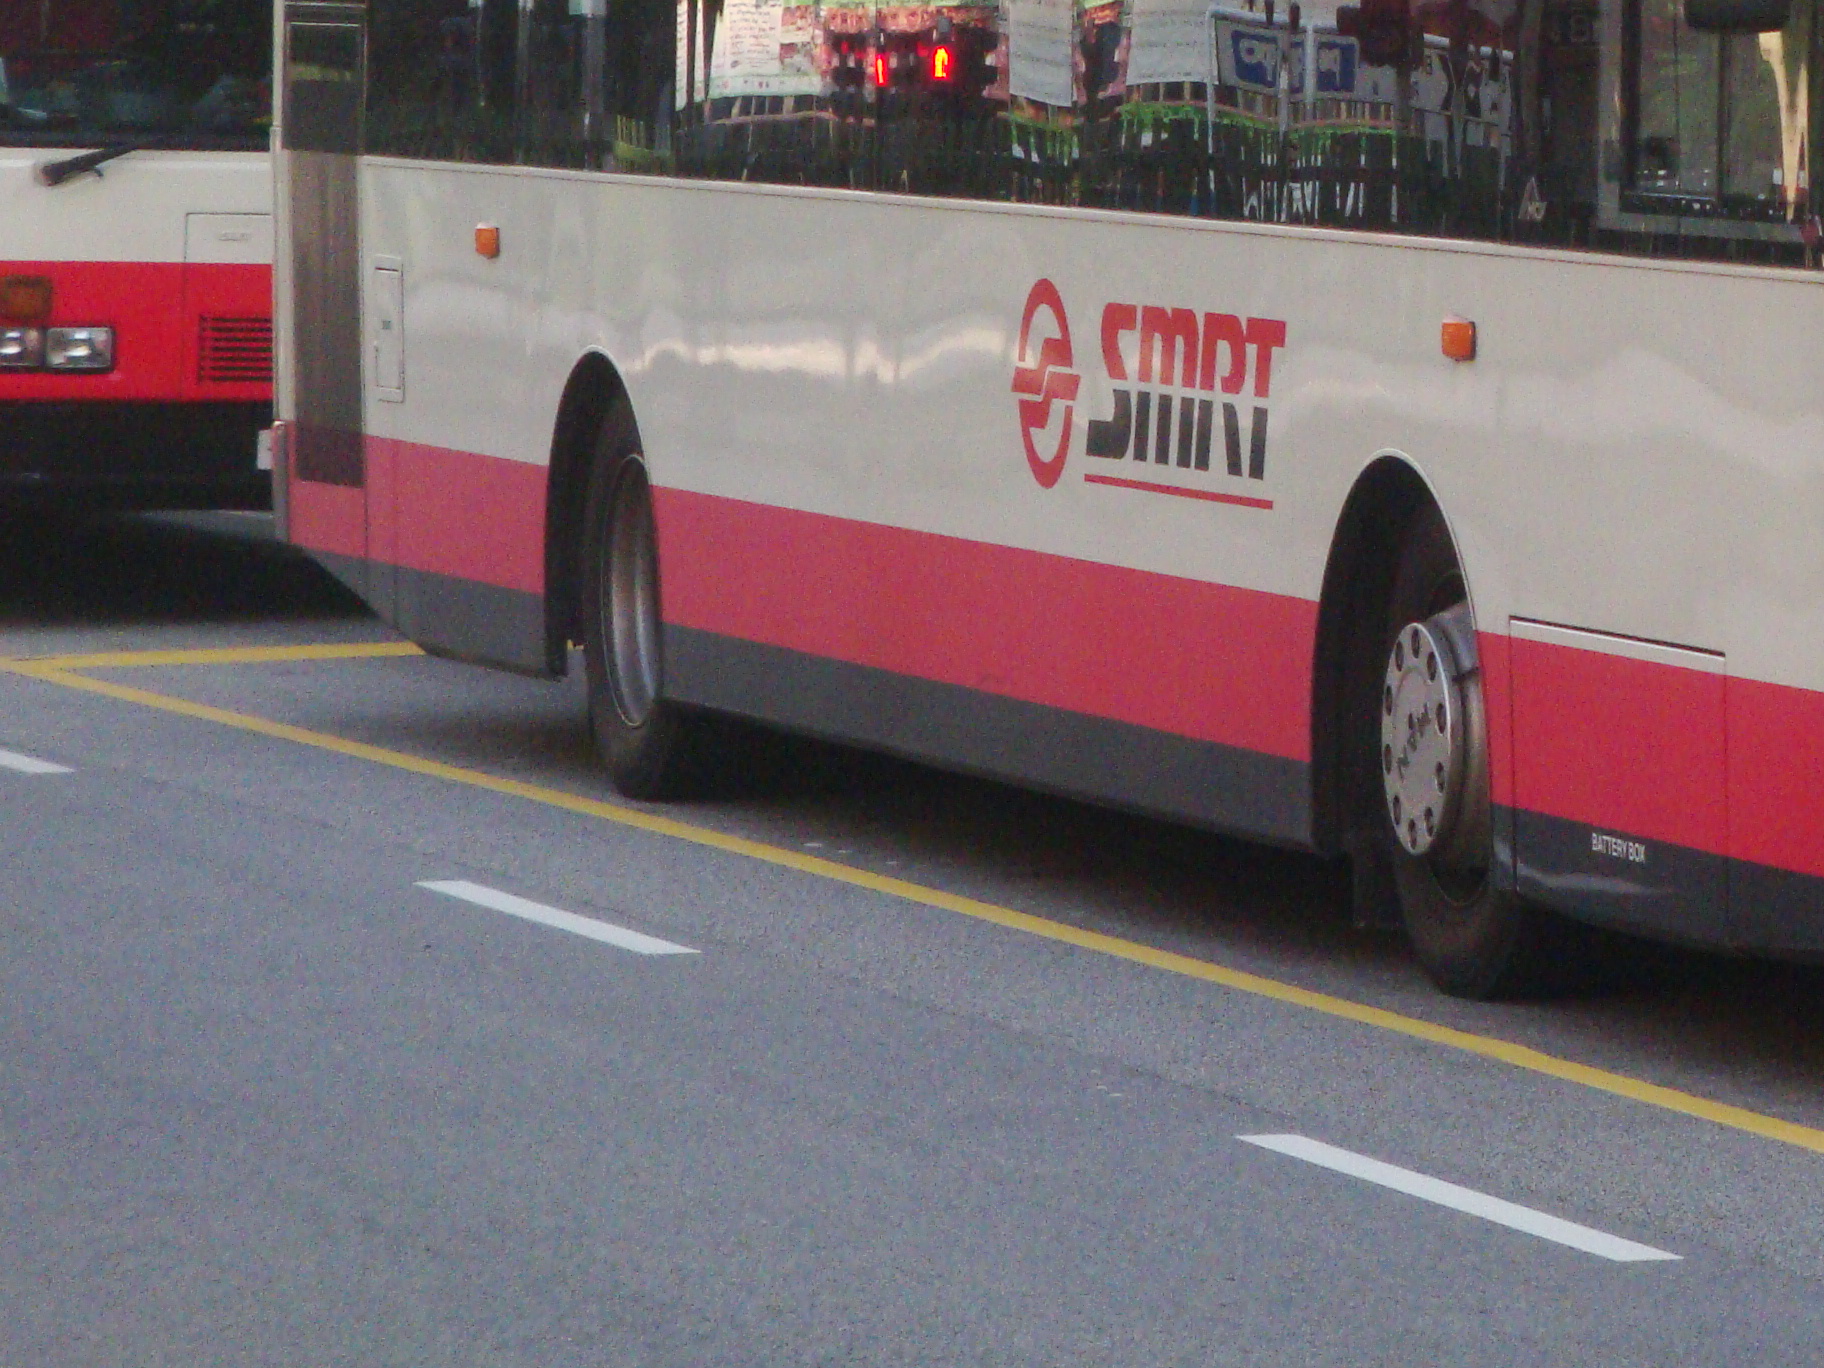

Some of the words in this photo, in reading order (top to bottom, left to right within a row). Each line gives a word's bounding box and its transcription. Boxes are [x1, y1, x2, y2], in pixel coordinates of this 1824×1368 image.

[1086, 301, 1287, 481] SMRT
[1591, 832, 1628, 859] BATTERY
[1628, 841, 1646, 864] BOX
